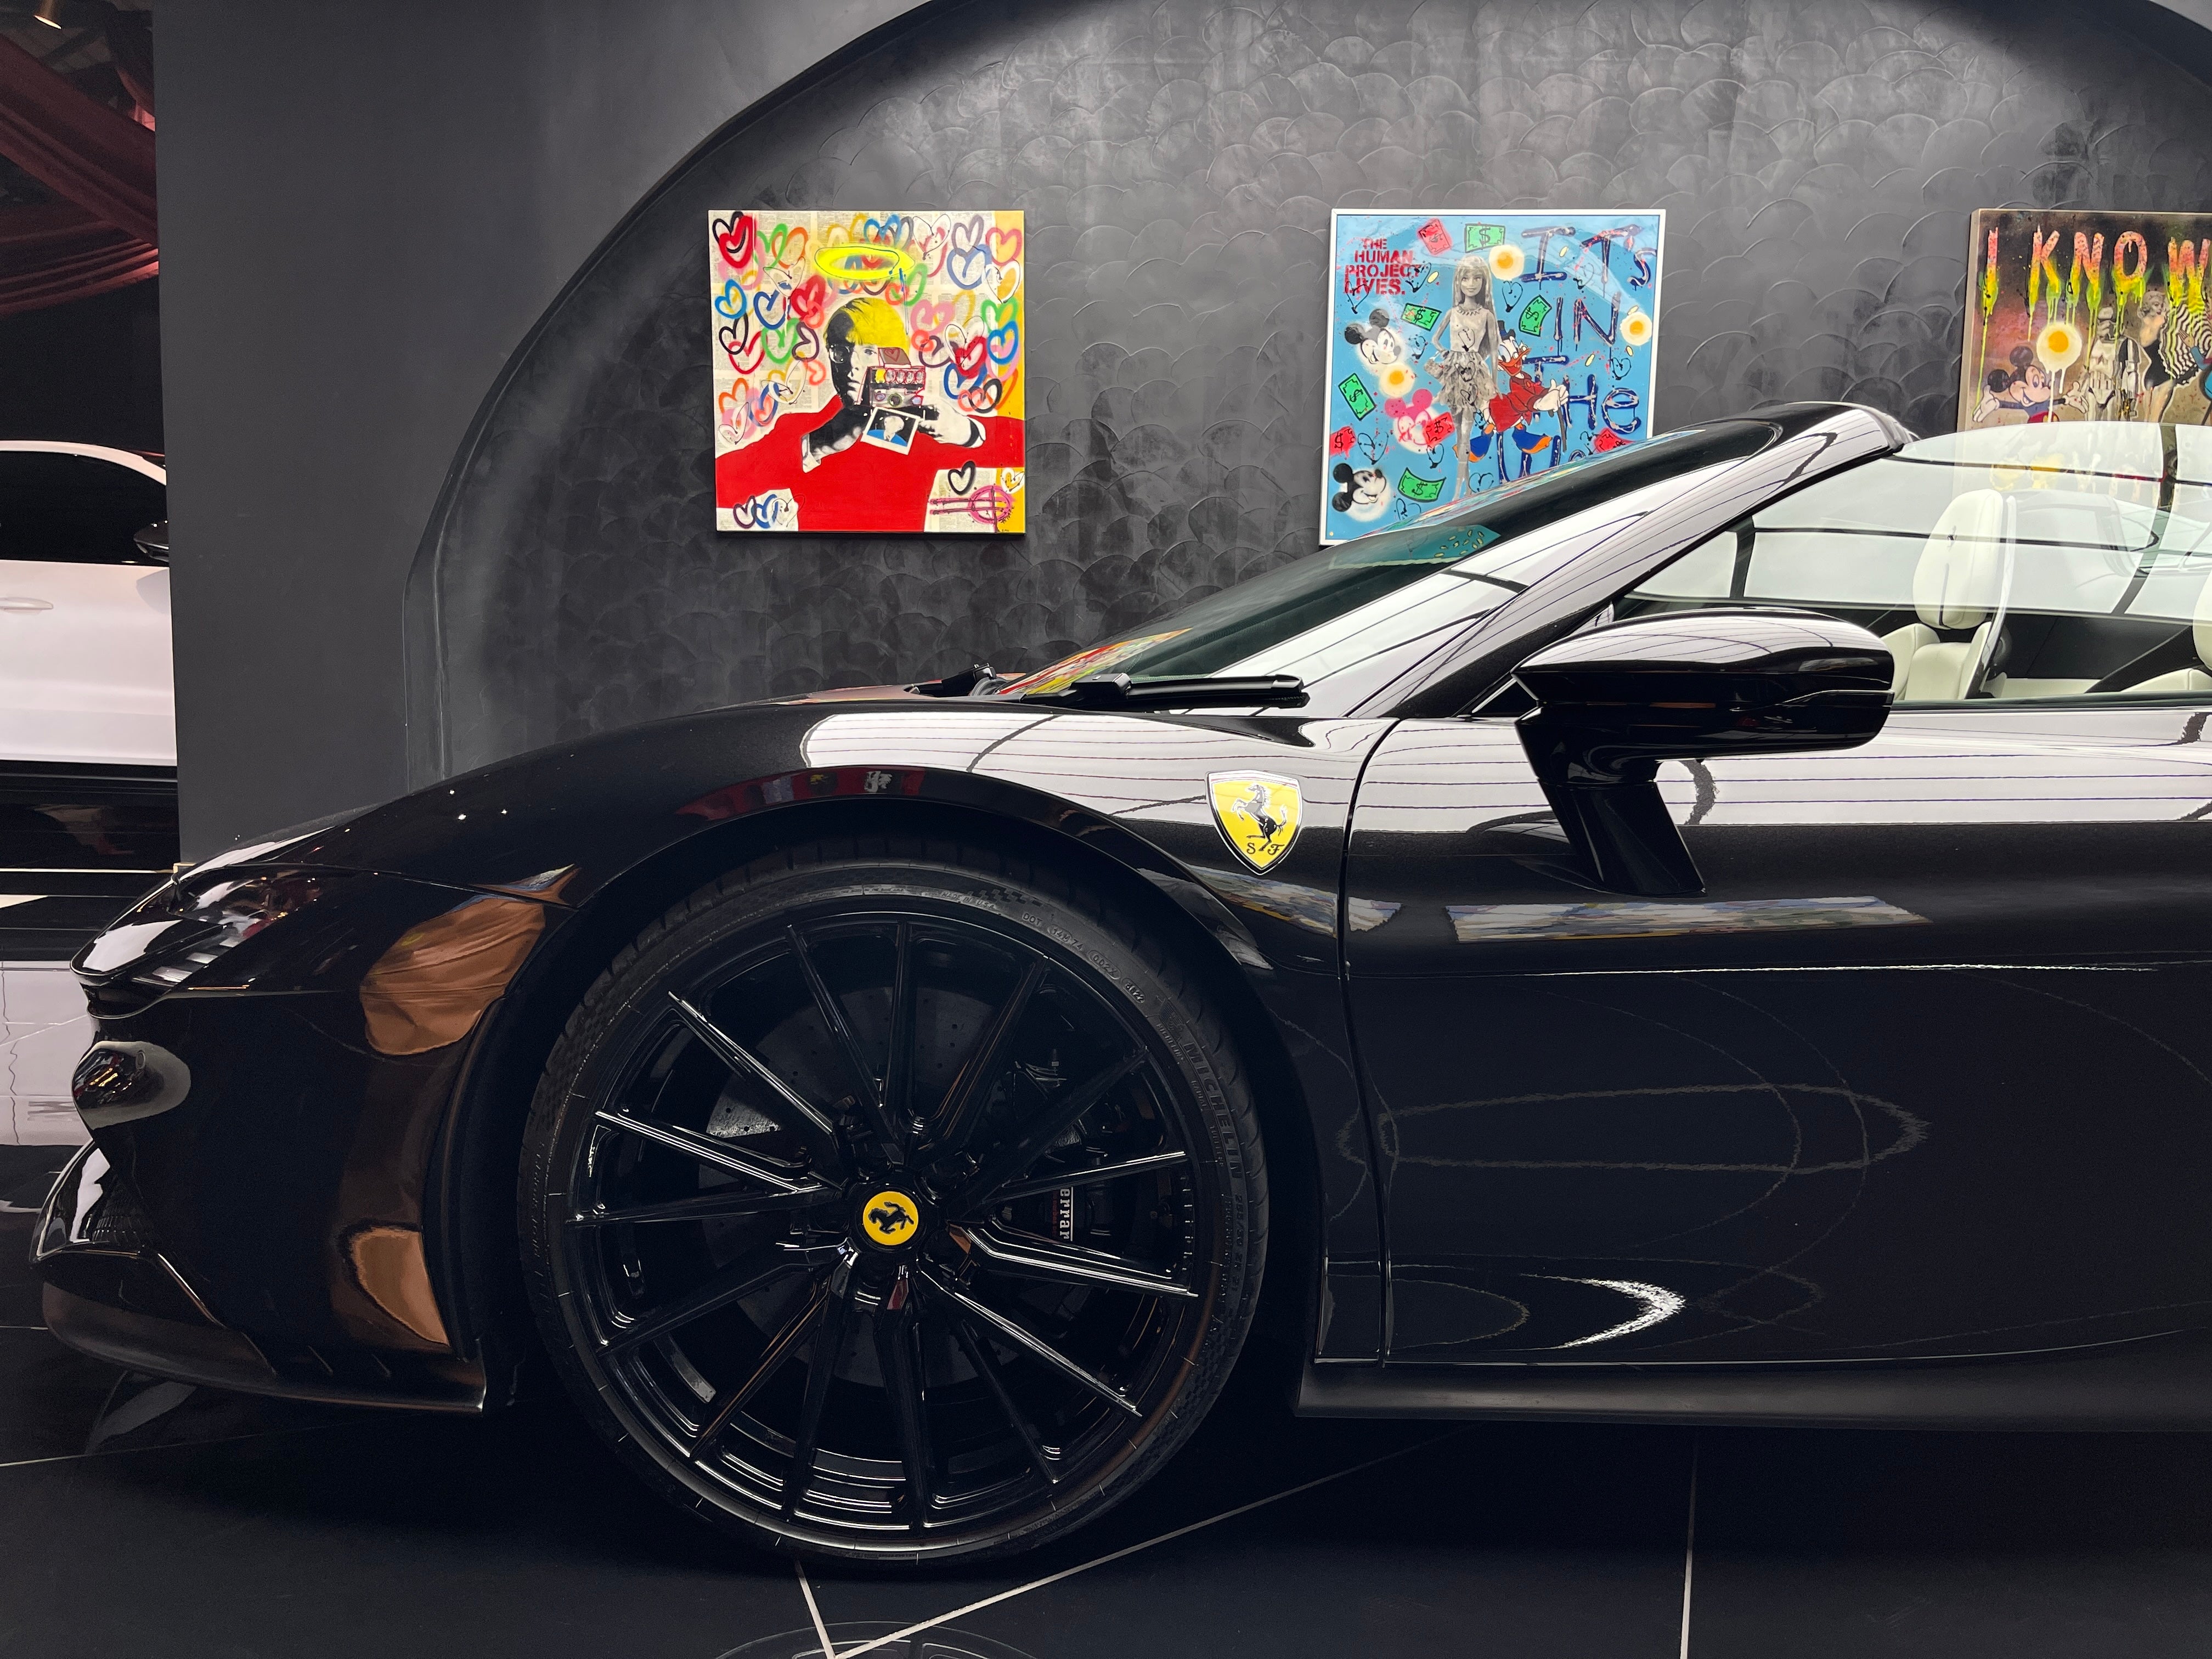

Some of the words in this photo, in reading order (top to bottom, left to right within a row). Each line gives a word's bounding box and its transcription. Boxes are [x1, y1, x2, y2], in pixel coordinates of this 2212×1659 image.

[1362, 238, 1387, 249] THE
[1354, 250, 1414, 263] HUMAN
[1345, 264, 1422, 278] PROJECT
[2029, 224, 2211, 313] KNOW
[1344, 276, 1406, 295] LIVES.
[1554, 291, 1621, 347] IN
[1246, 842, 1256, 855] S
[1267, 843, 1285, 856] F
[1023, 913, 1041, 926] DOT
[1183, 1043, 1243, 1179] MICHELIN
[1059, 1187, 1074, 1242] errar
